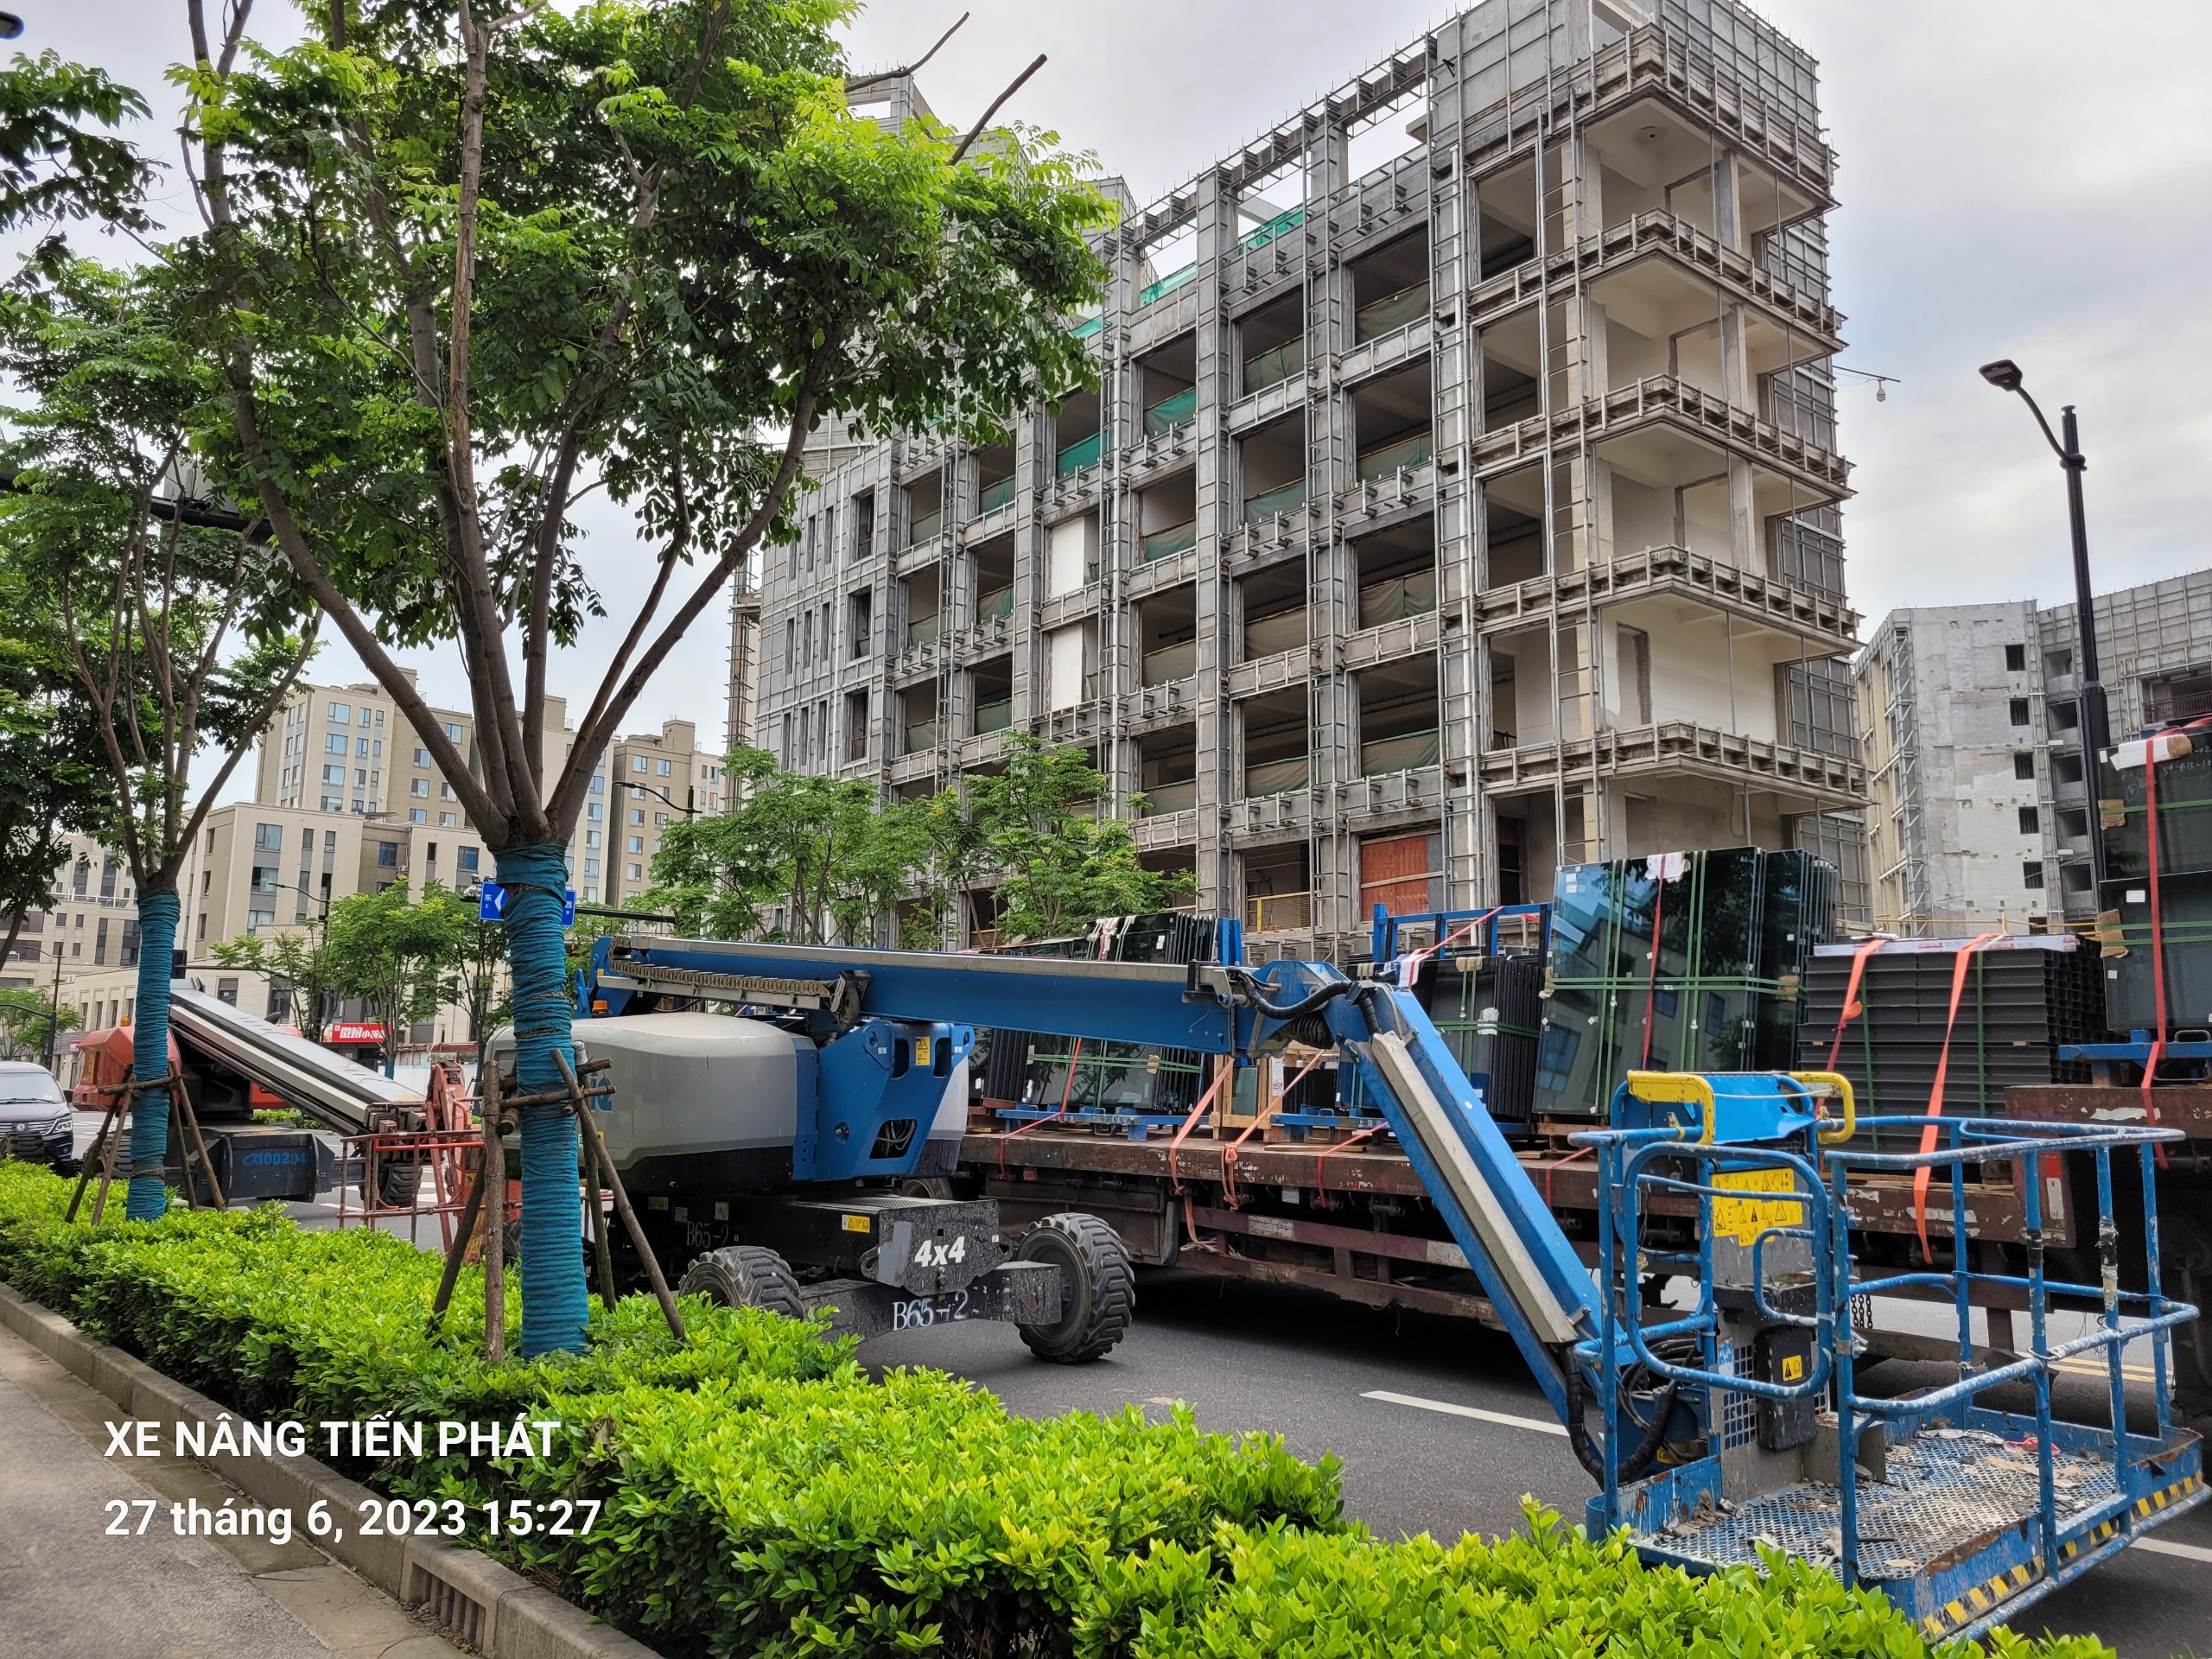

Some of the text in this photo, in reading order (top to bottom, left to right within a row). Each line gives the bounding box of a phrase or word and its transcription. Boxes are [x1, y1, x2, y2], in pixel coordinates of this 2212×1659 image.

[484, 893, 493, 902] 东
[687, 1221, 729, 1249] B65-2
[914, 1236, 966, 1268] 4x4
[893, 1290, 969, 1331] B65-2
